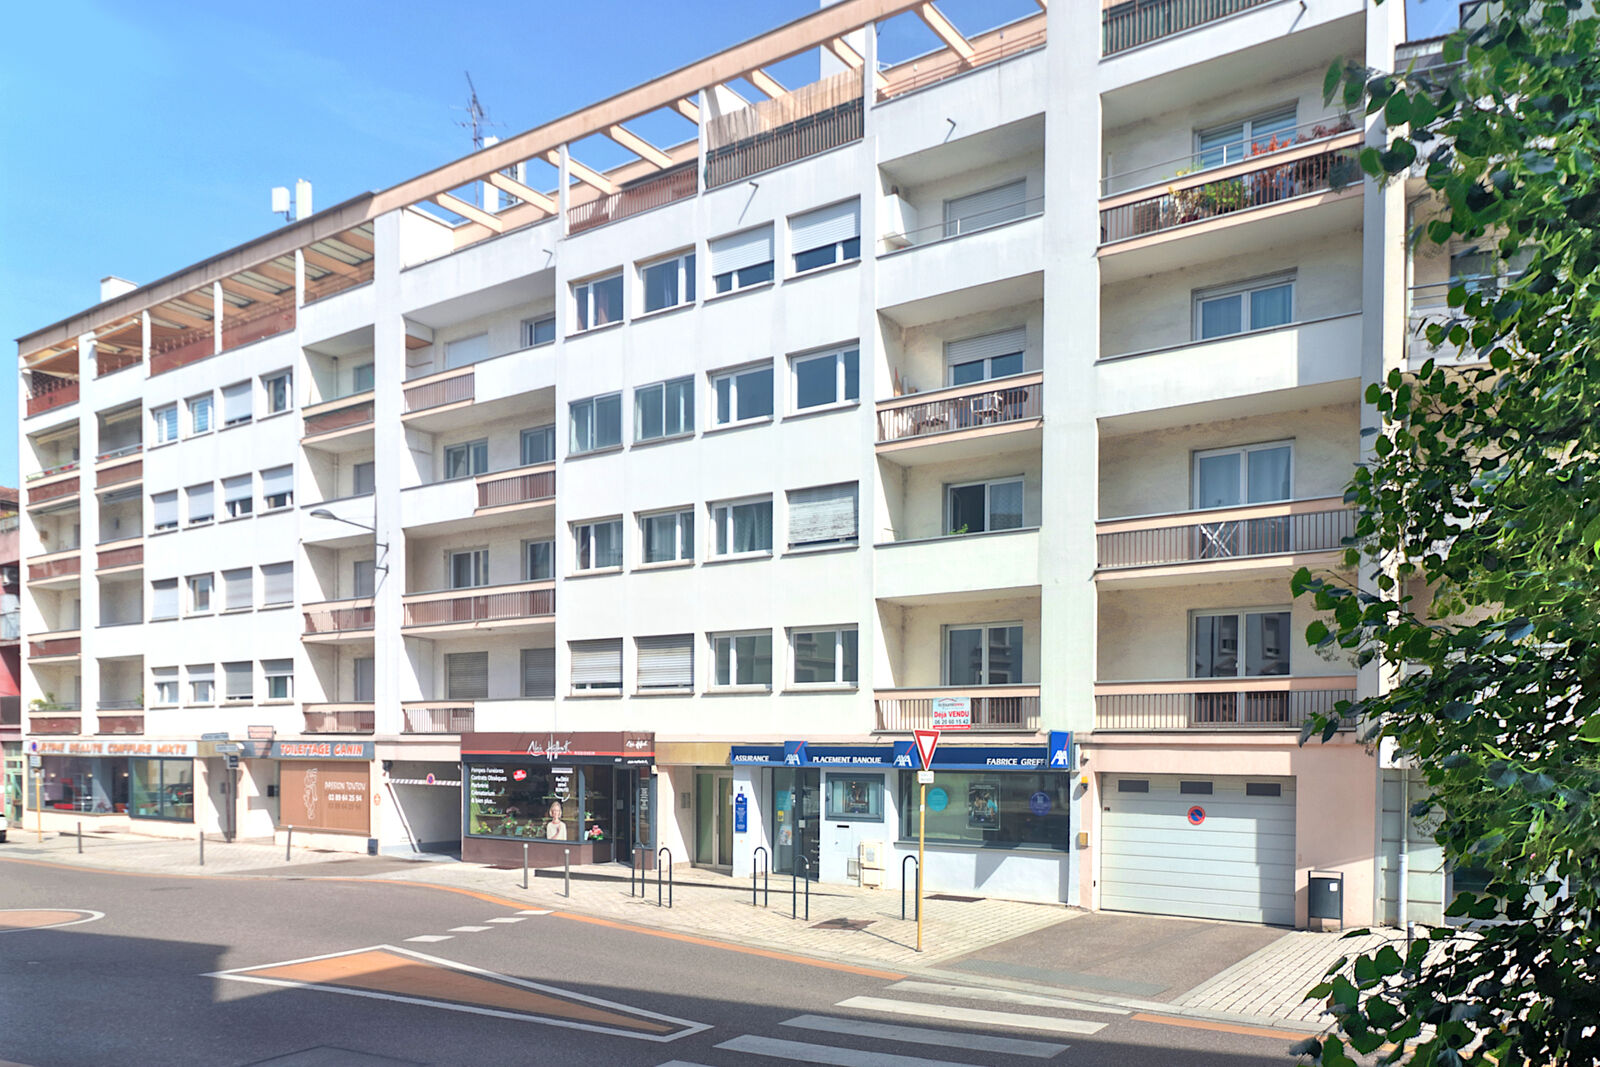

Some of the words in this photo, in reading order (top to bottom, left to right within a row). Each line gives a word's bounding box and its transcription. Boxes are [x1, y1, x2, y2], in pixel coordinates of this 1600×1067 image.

[948, 710, 969, 718] VENDU
[156, 743, 188, 755] MIXTE
[280, 743, 331, 756] TOILETTAGE
[334, 743, 364, 756] CANIN
[784, 753, 801, 765] AXA
[852, 756, 882, 764] BANQUE
[893, 755, 913, 767] AXA
[986, 758, 1018, 766] FABRICE
[1050, 750, 1068, 765] AXA
